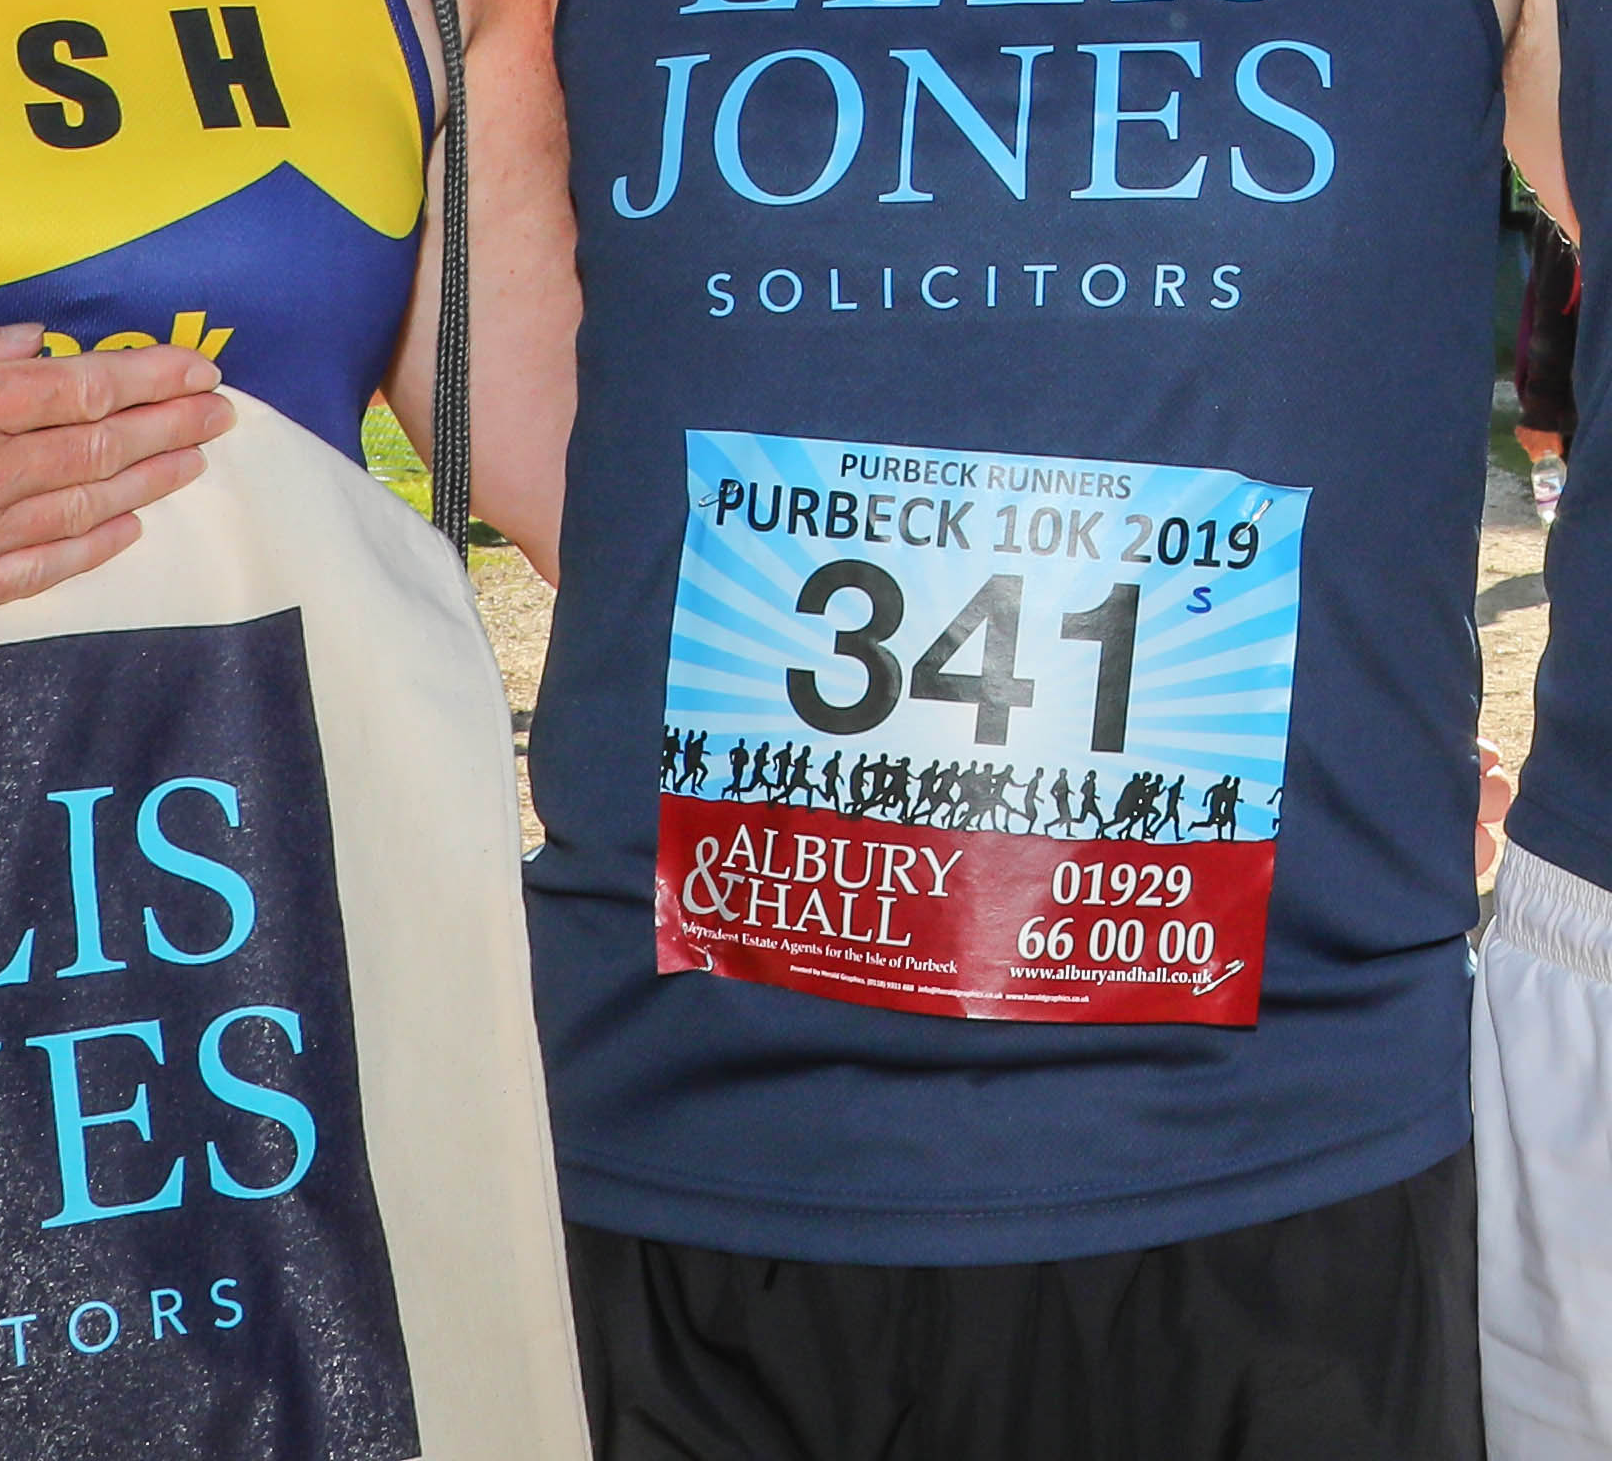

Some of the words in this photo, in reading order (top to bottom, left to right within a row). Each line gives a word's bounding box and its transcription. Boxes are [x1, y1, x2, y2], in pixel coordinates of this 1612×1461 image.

[610, 39, 1336, 220] JONES
[705, 262, 1244, 317] SOLICITORS
[840, 453, 978, 488] PURBECK
[986, 464, 1132, 500] RUNNERS
[715, 478, 975, 550] PURBECK
[993, 505, 1103, 560] 10K
[1121, 514, 1260, 570] 2019
[785, 558, 1141, 754] 341
[721, 823, 964, 898] ALBURY
[1051, 859, 1192, 909] 01929
[742, 934, 778, 949] Estate
[780, 940, 823, 956] Agents
[825, 944, 843, 959] for
[844, 947, 863, 963] the
[865, 950, 887, 967] Isle
[888, 954, 903, 969] of
[905, 957, 958, 974] Purbeck
[1016, 916, 1077, 963] 66
[1089, 917, 1145, 965] 00
[1157, 920, 1215, 965] 00
[1010, 962, 1214, 986] www.alburyandhall.co.uk
